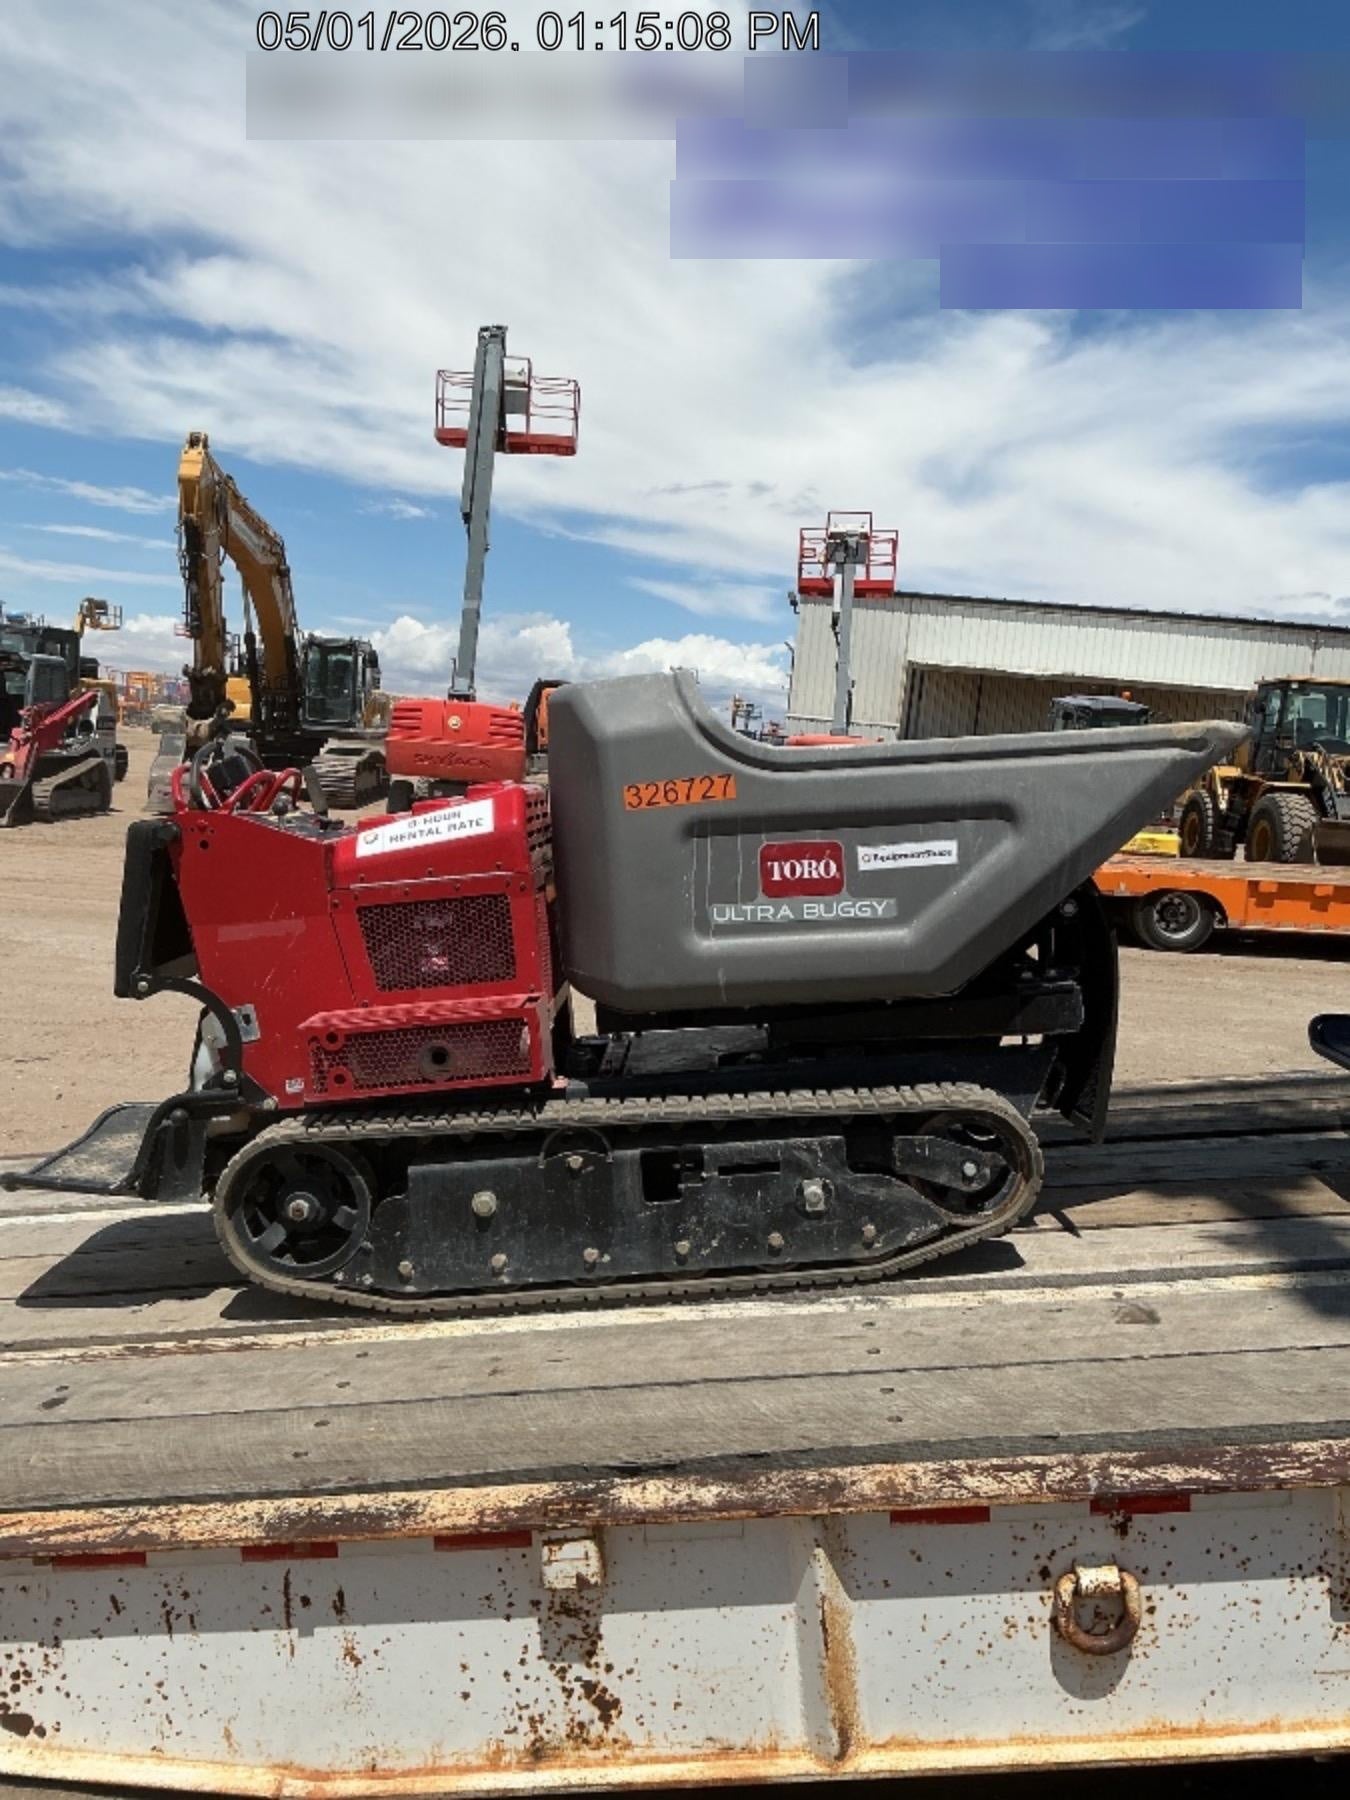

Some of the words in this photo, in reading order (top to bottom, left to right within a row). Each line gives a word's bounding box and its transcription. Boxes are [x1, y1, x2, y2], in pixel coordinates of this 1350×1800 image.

[626, 774, 733, 809] 326727
[767, 858, 837, 881] TORO
[713, 905, 794, 922] ULTRA
[803, 901, 887, 919] BUGGY
